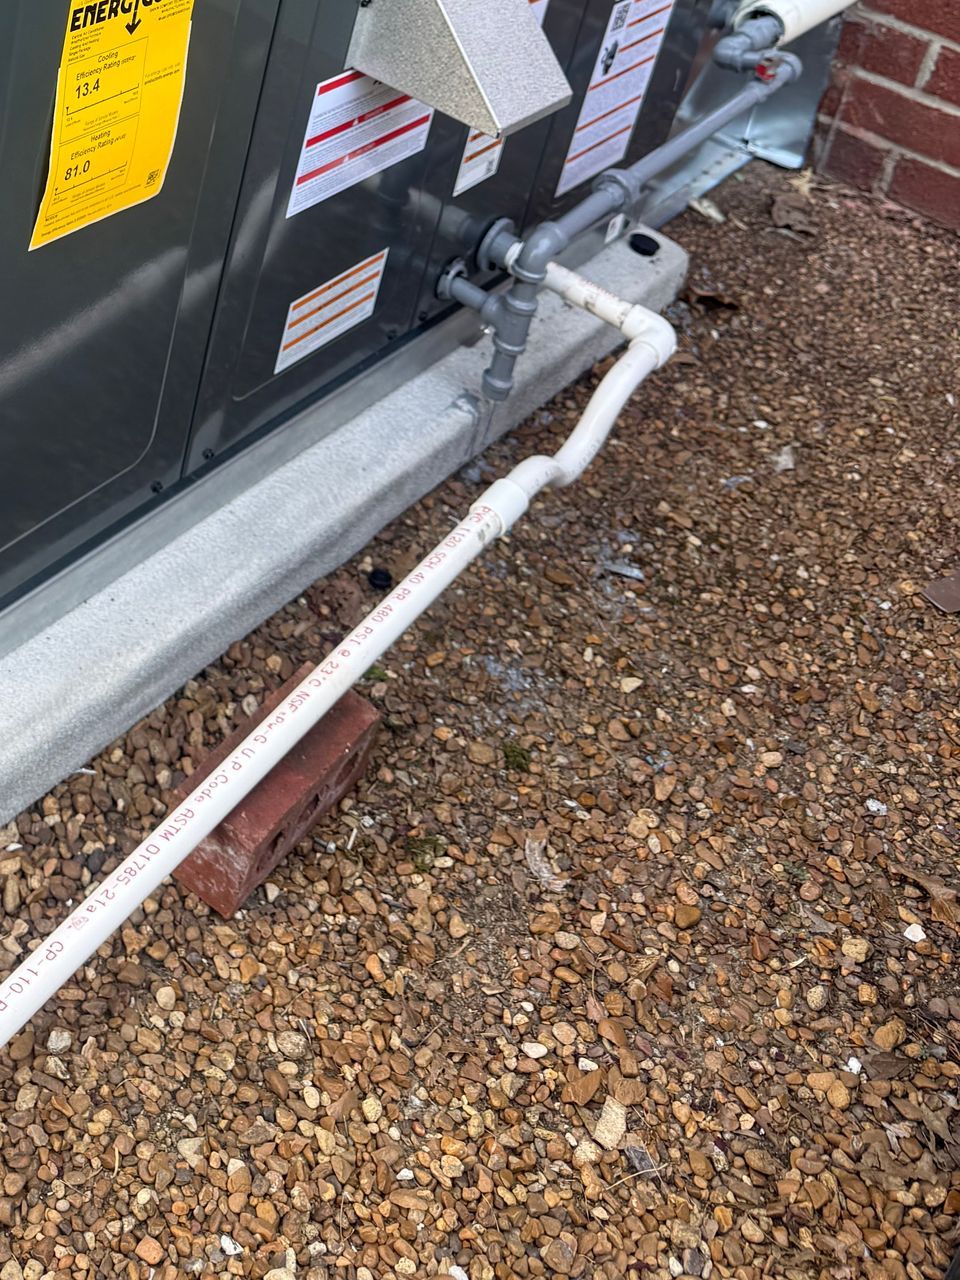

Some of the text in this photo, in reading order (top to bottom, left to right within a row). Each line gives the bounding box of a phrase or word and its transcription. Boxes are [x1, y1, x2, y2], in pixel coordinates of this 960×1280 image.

[98, 51, 118, 64] Cooling
[76, 60, 120, 81] Efficiency Rating
[76, 78, 100, 99] 13.4
[91, 130, 110, 142] Heating
[71, 138, 114, 160] Efficiency Rating
[65, 160, 90, 180] 81.0
[474, 506, 491, 523] PVC
[446, 527, 470, 548] 1120
[424, 552, 446, 570] SCH
[409, 572, 424, 584] 40
[394, 588, 411, 602] PR
[372, 605, 394, 622] 480
[350, 627, 373, 646] PSI
[289, 690, 310, 712] NSF
[159, 808, 194, 841] ASTM
